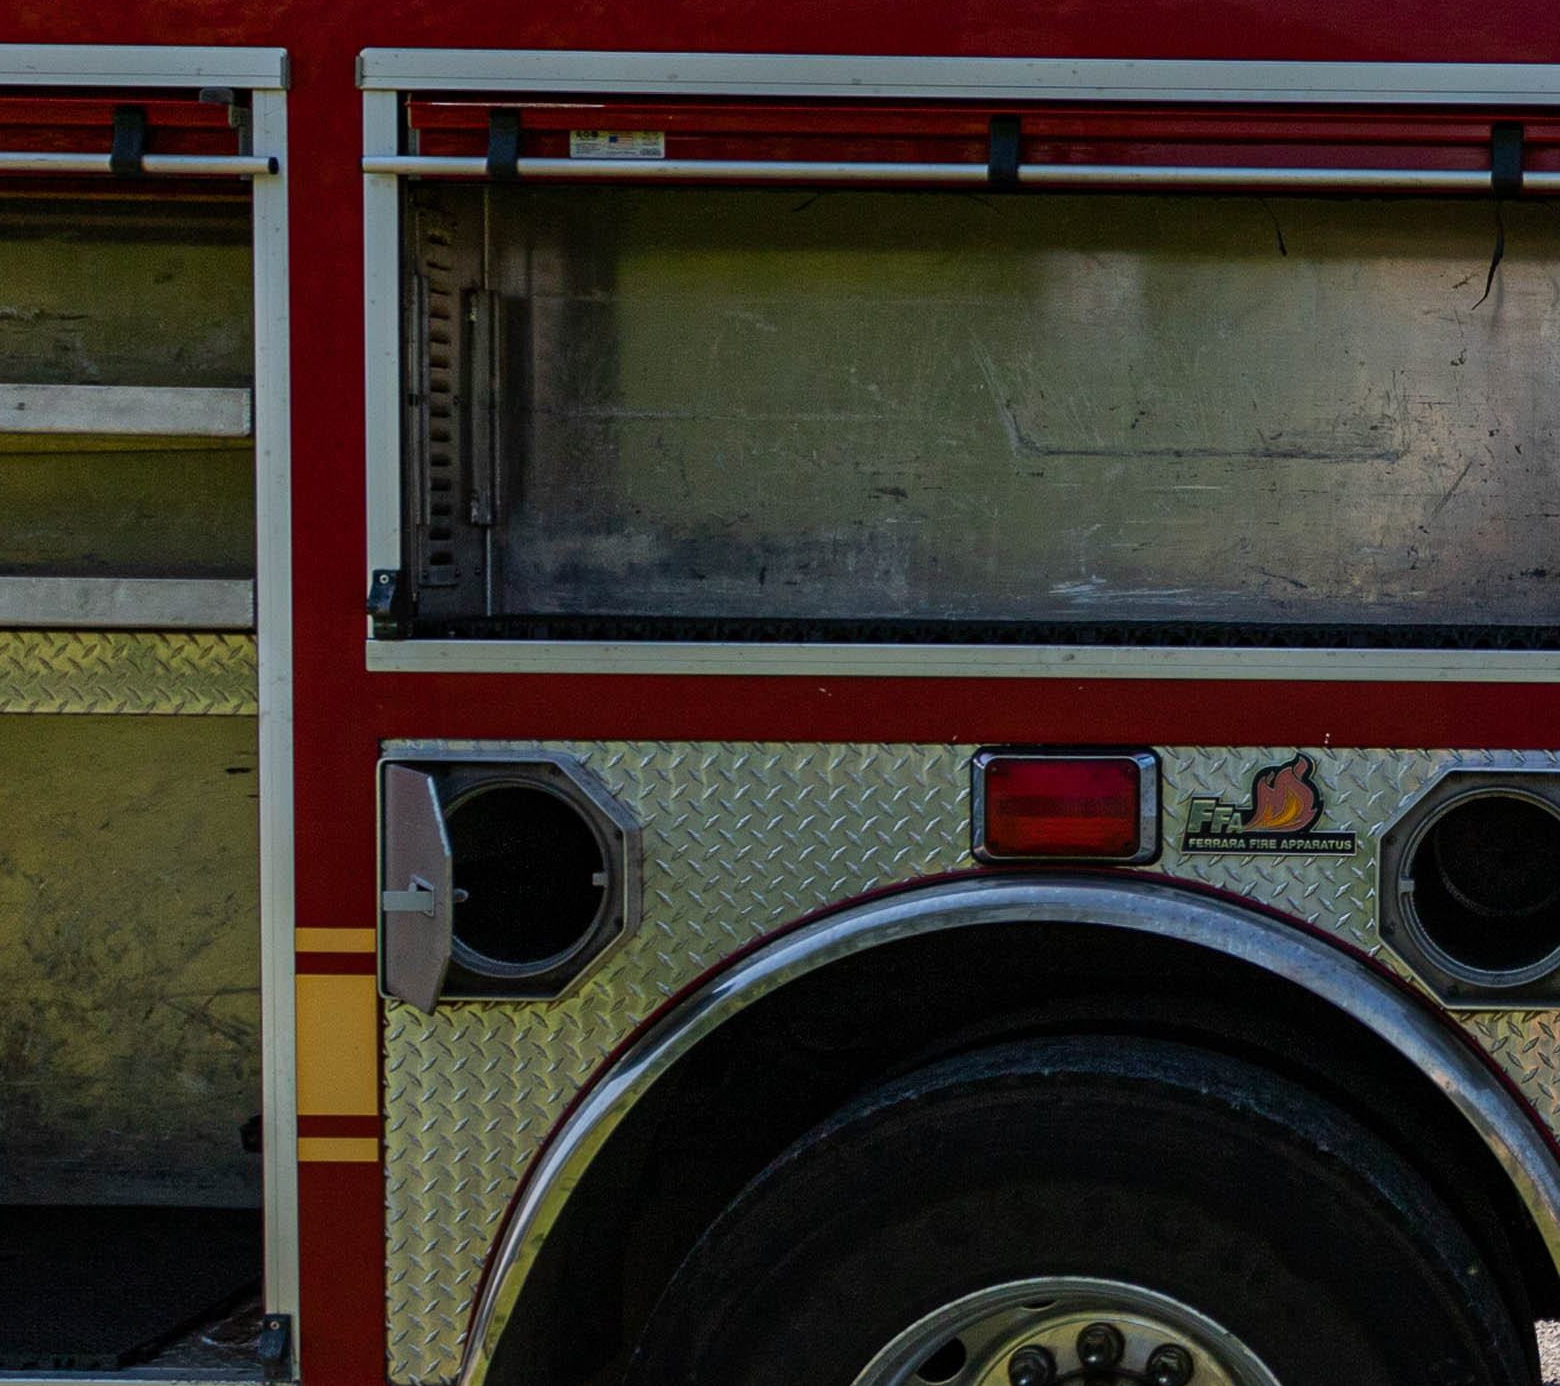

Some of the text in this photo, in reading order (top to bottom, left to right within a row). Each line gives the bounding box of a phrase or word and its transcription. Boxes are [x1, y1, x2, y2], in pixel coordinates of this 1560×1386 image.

[1188, 799, 1243, 833] FFA
[1189, 838, 1352, 849] FERRARA FIRE APPARATUS
